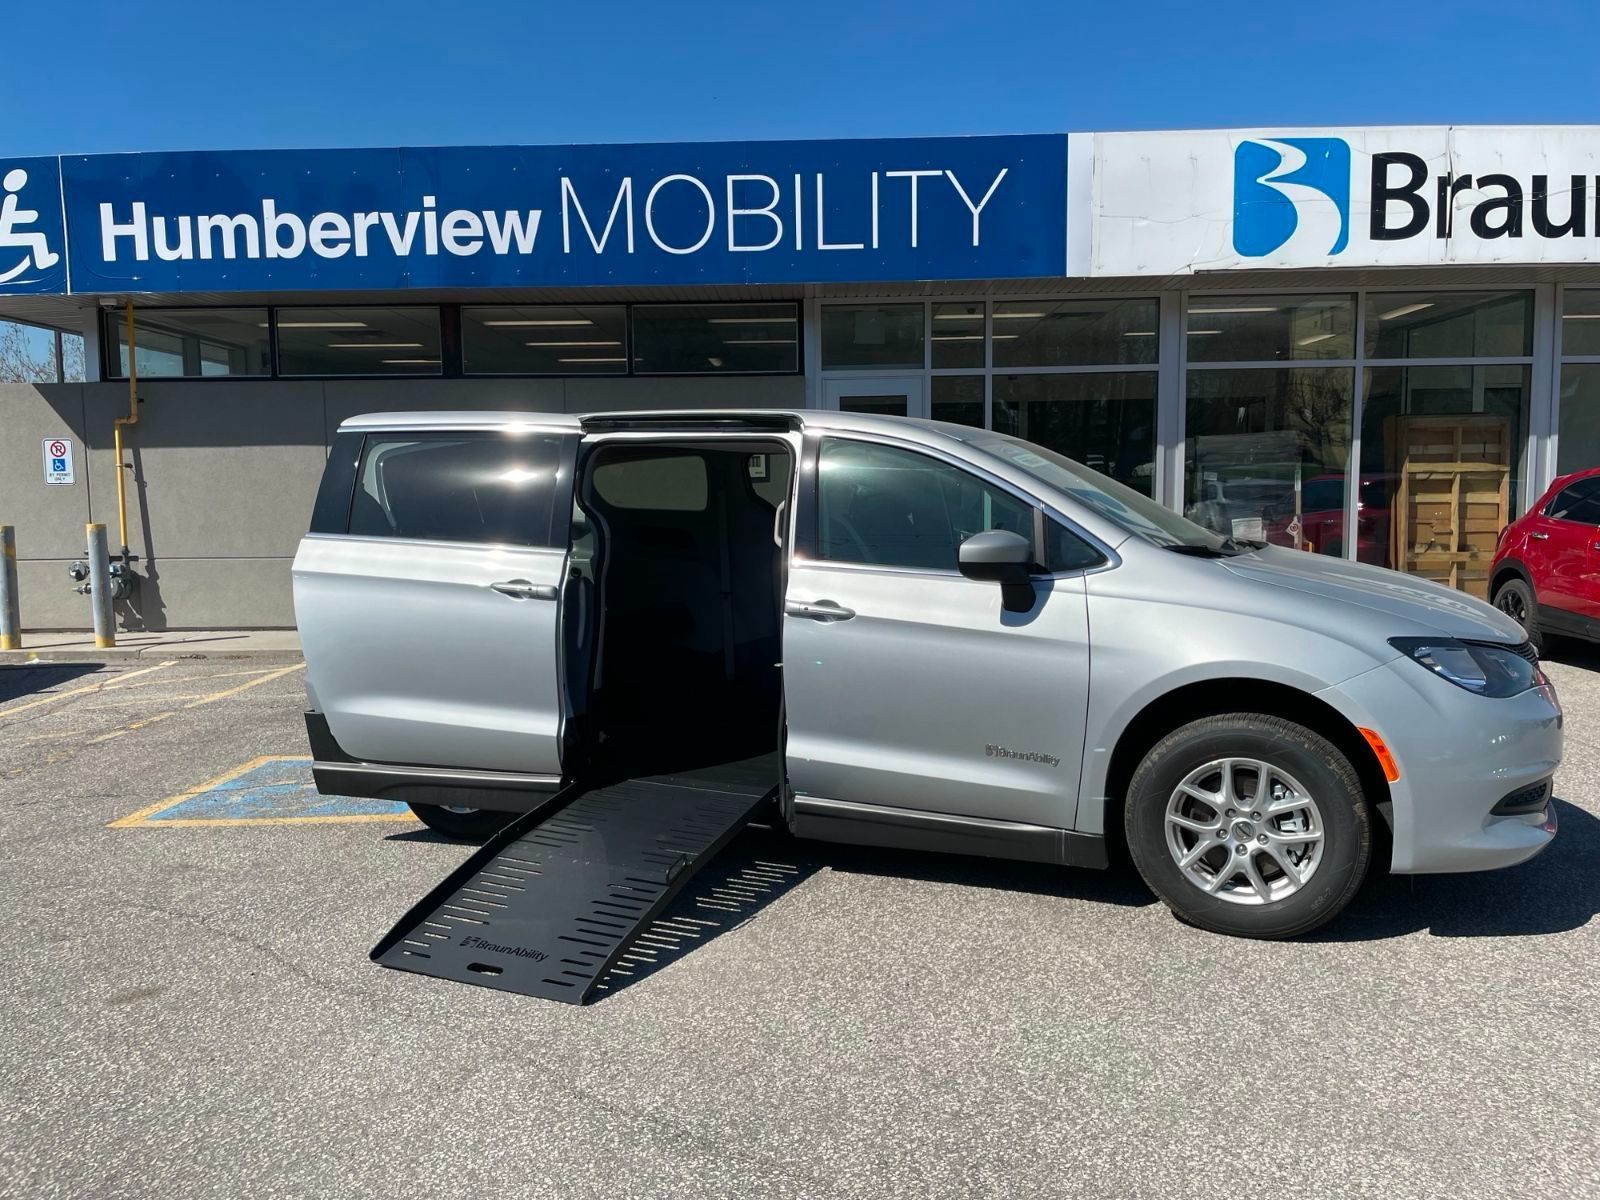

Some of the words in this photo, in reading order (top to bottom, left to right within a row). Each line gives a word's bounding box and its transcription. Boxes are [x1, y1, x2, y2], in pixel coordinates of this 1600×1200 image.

[99, 195, 542, 262] Humberview
[560, 168, 1009, 255] MOBILITY
[1000, 747, 1061, 768] BraunAbility
[476, 940, 550, 962] BraunAbility
